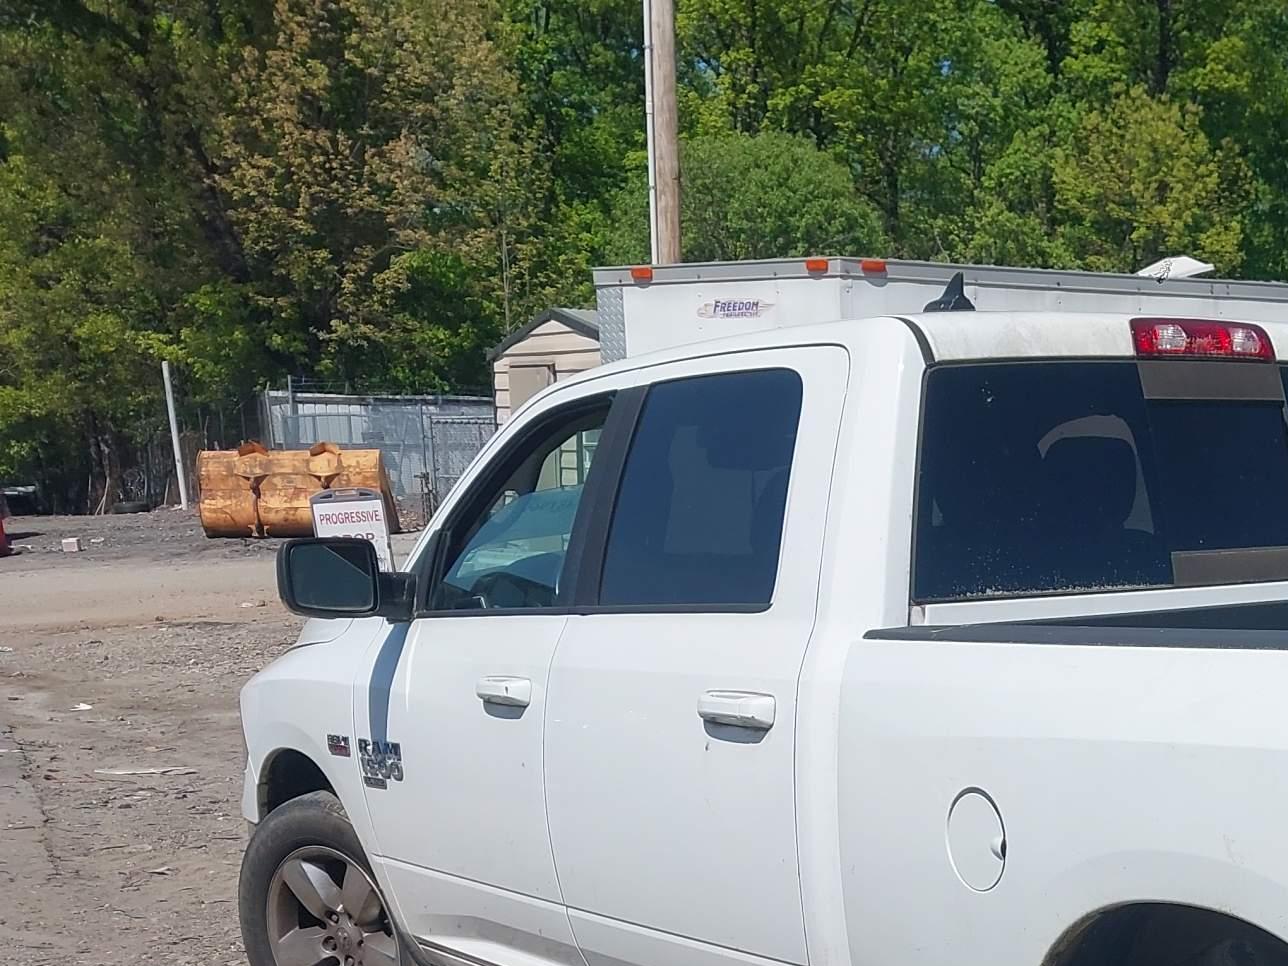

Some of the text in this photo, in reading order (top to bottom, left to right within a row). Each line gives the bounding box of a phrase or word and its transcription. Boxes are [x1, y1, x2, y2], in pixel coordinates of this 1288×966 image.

[712, 300, 760, 314] FREEDOM
[319, 509, 381, 525] PROGRESSIVE
[357, 738, 402, 762] RAM
